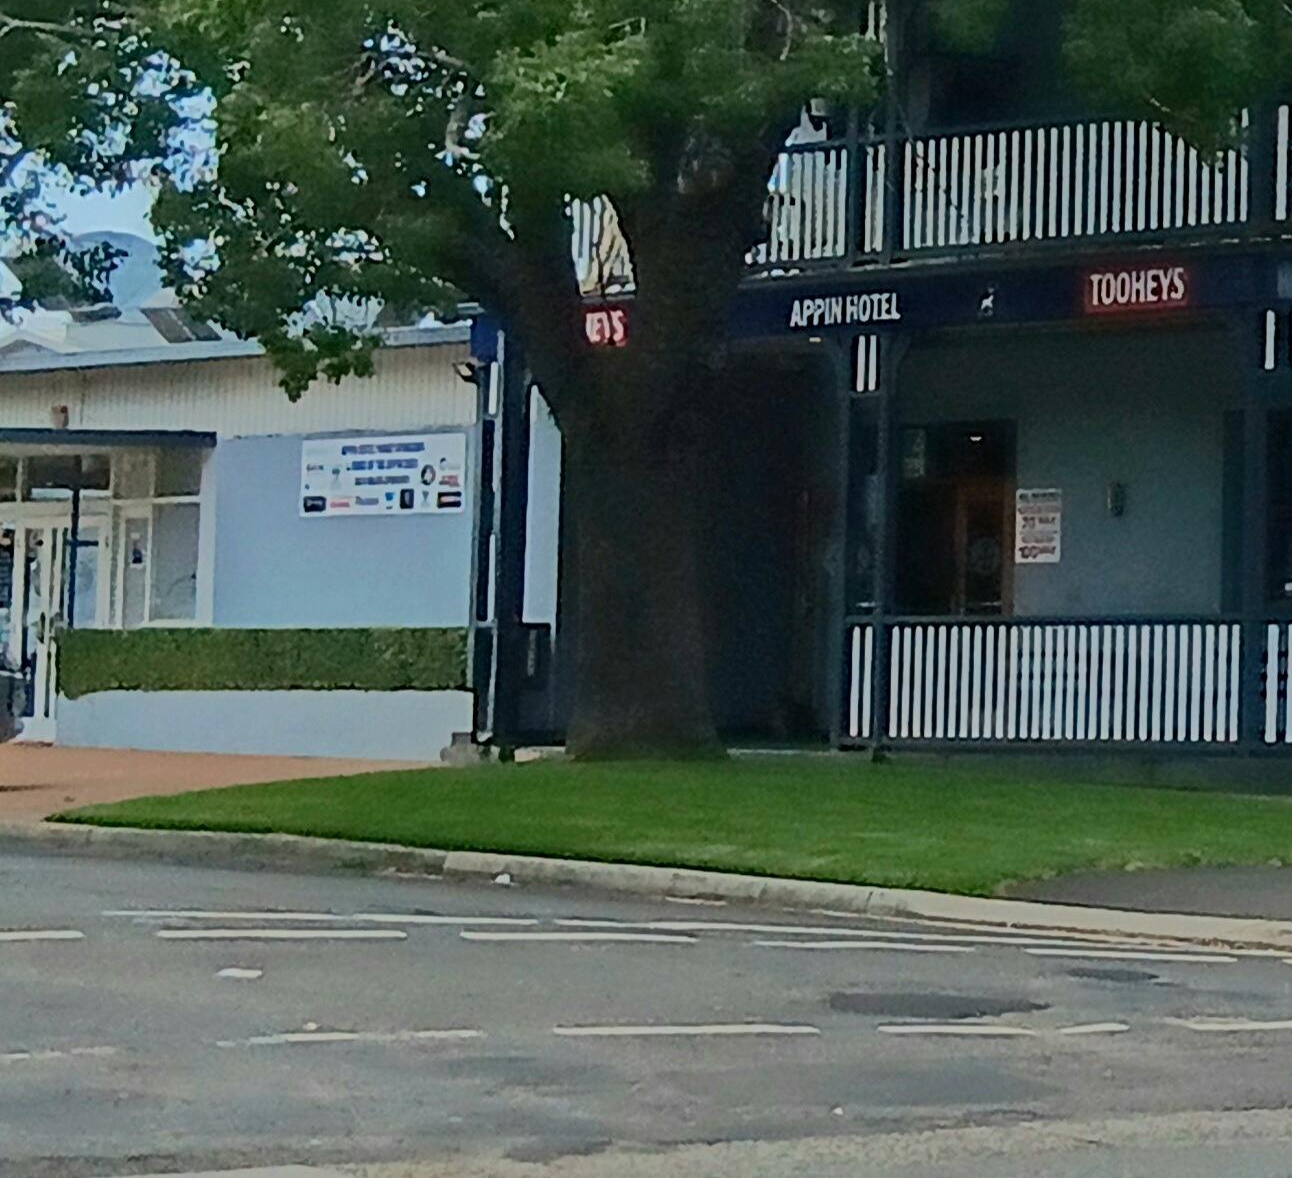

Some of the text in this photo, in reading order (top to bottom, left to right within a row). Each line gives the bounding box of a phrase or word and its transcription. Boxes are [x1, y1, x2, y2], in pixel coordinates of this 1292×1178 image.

[1090, 267, 1184, 306] TOOHEYS
[790, 292, 901, 327] APPIN HOTEL
